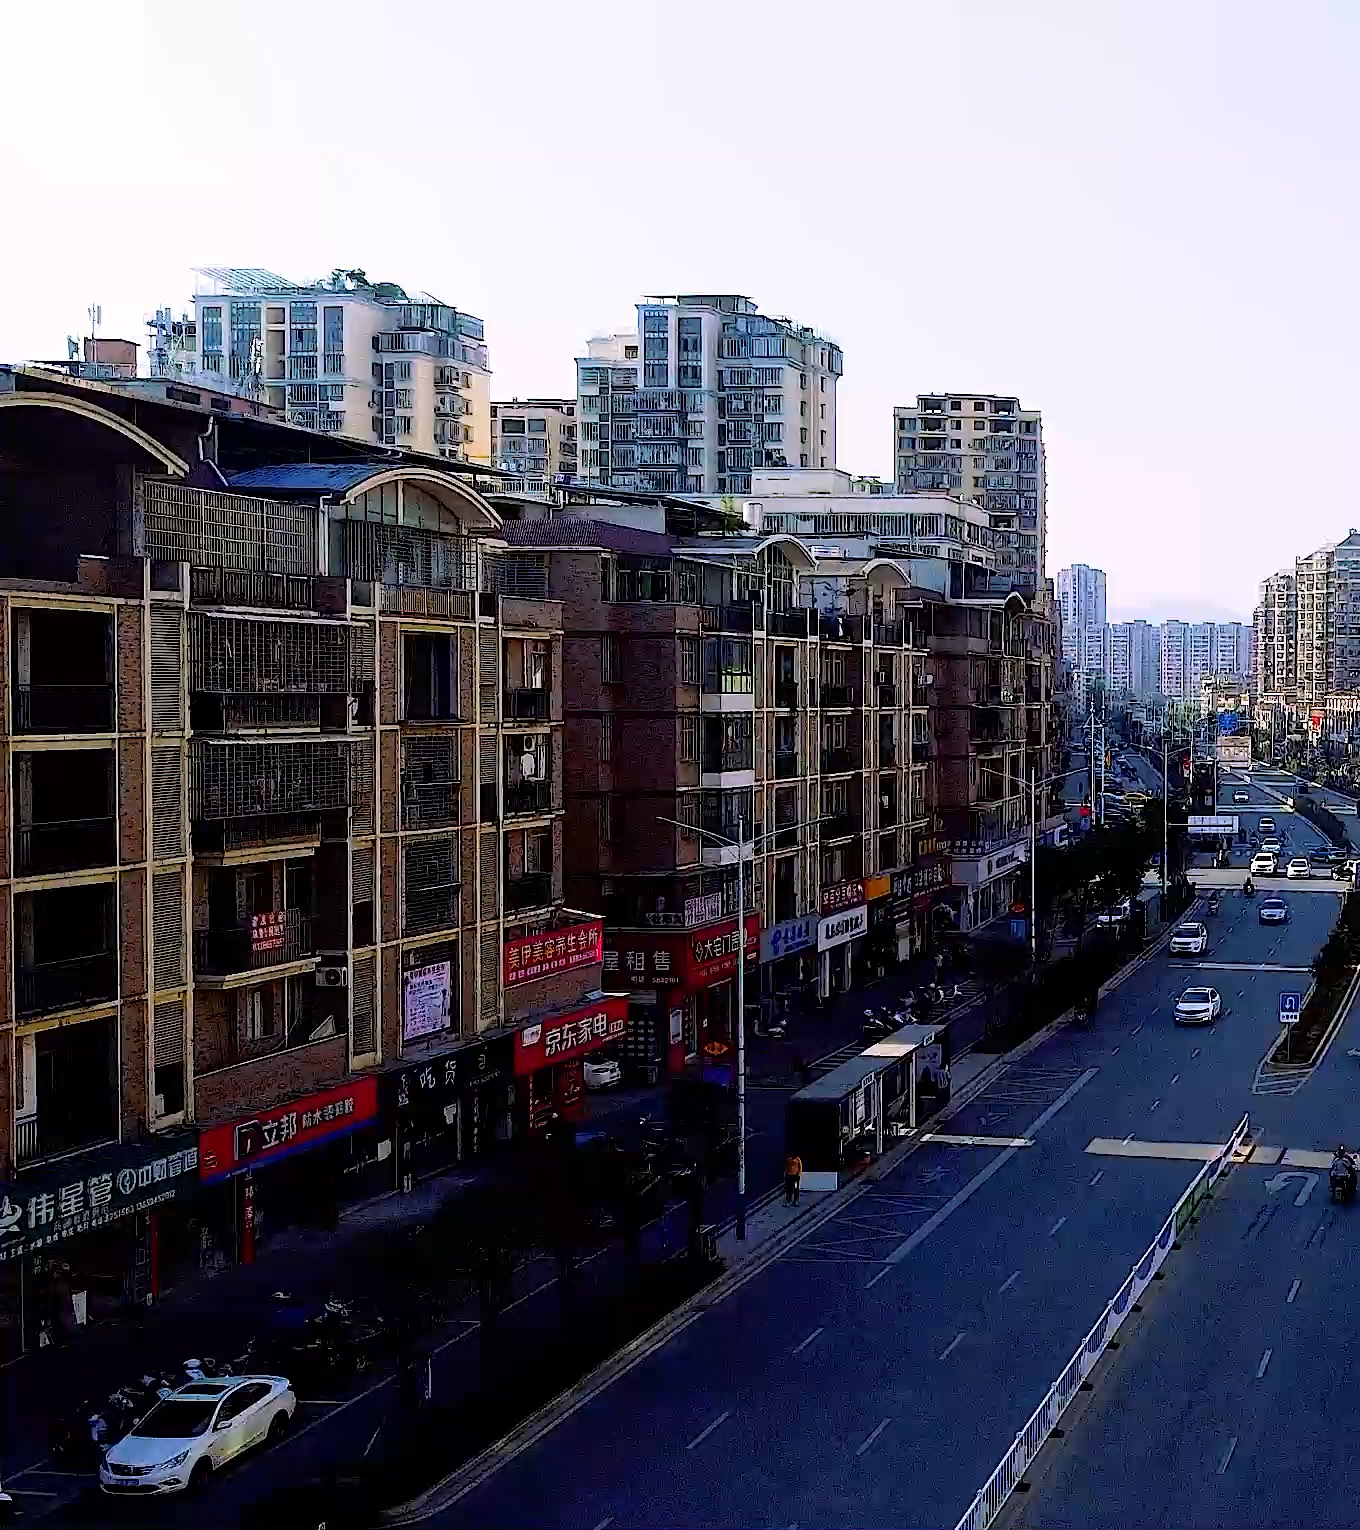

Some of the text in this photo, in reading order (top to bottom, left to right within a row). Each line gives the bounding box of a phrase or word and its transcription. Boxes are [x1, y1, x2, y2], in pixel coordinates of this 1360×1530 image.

[545, 1012, 608, 1057] 京东家电
[261, 1111, 298, 1150] 立邦
[27, 1172, 114, 1230] 伟星管
